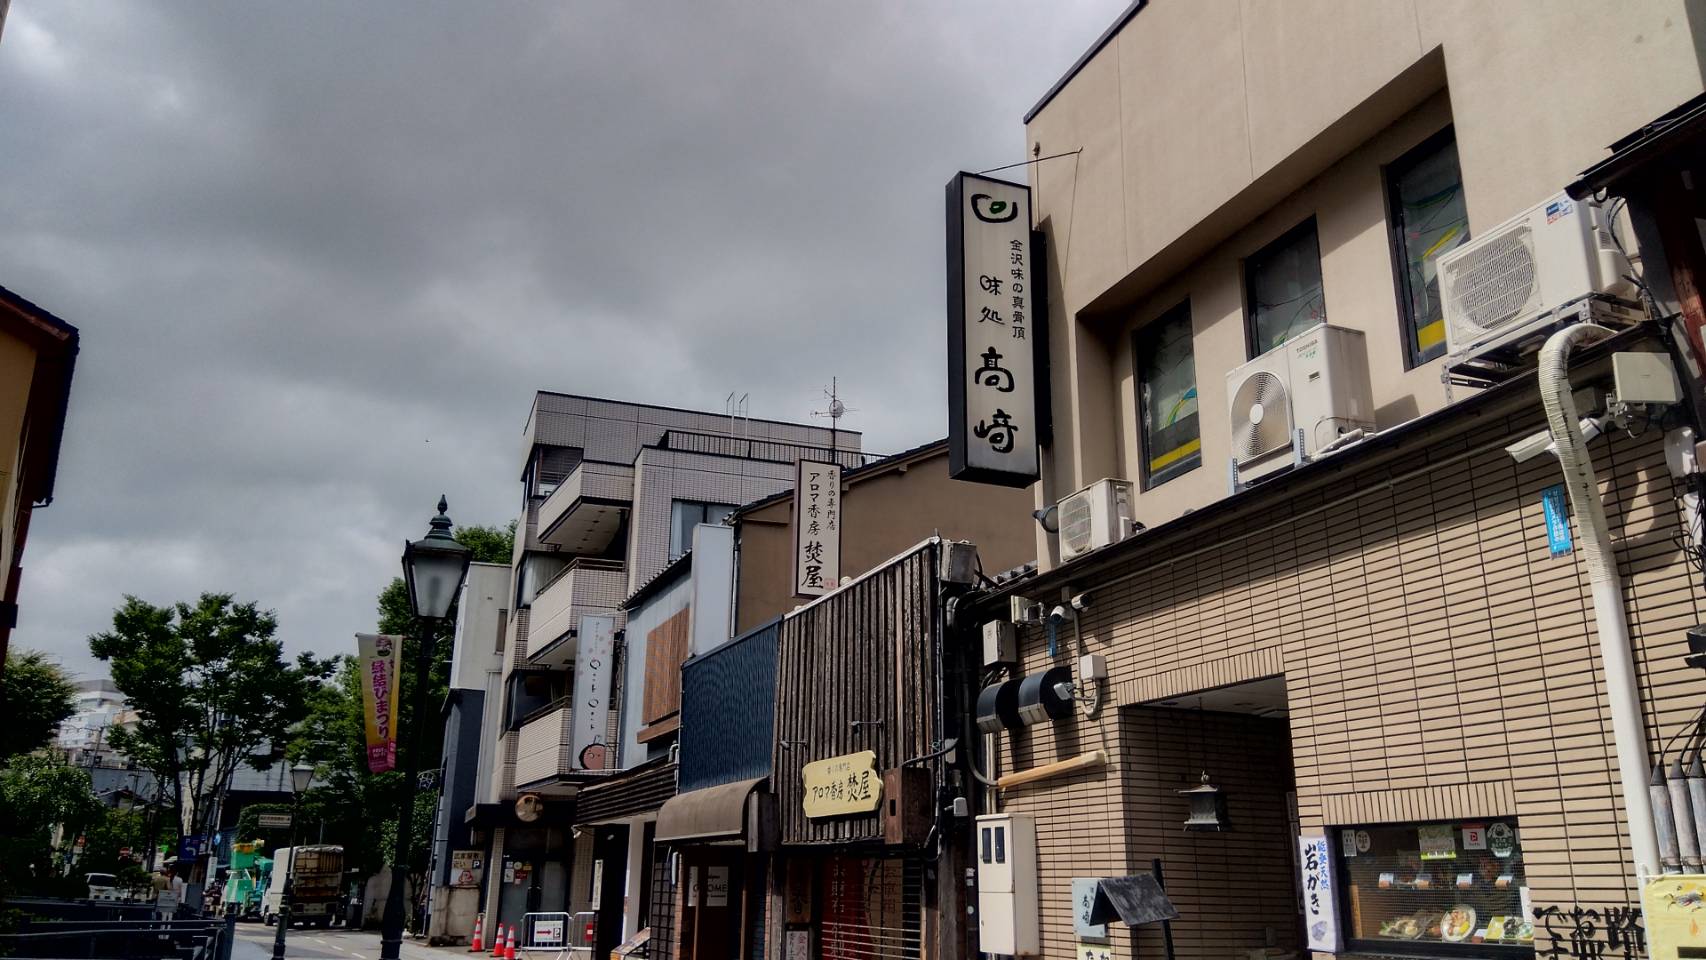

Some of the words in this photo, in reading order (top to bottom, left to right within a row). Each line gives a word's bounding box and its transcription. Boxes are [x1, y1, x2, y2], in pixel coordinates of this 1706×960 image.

[978, 274, 1005, 326] 味処
[1010, 239, 1026, 340] 金沢味の真骨頂
[807, 472, 821, 537] アロマ香房
[1304, 842, 1321, 916] 岩がき
